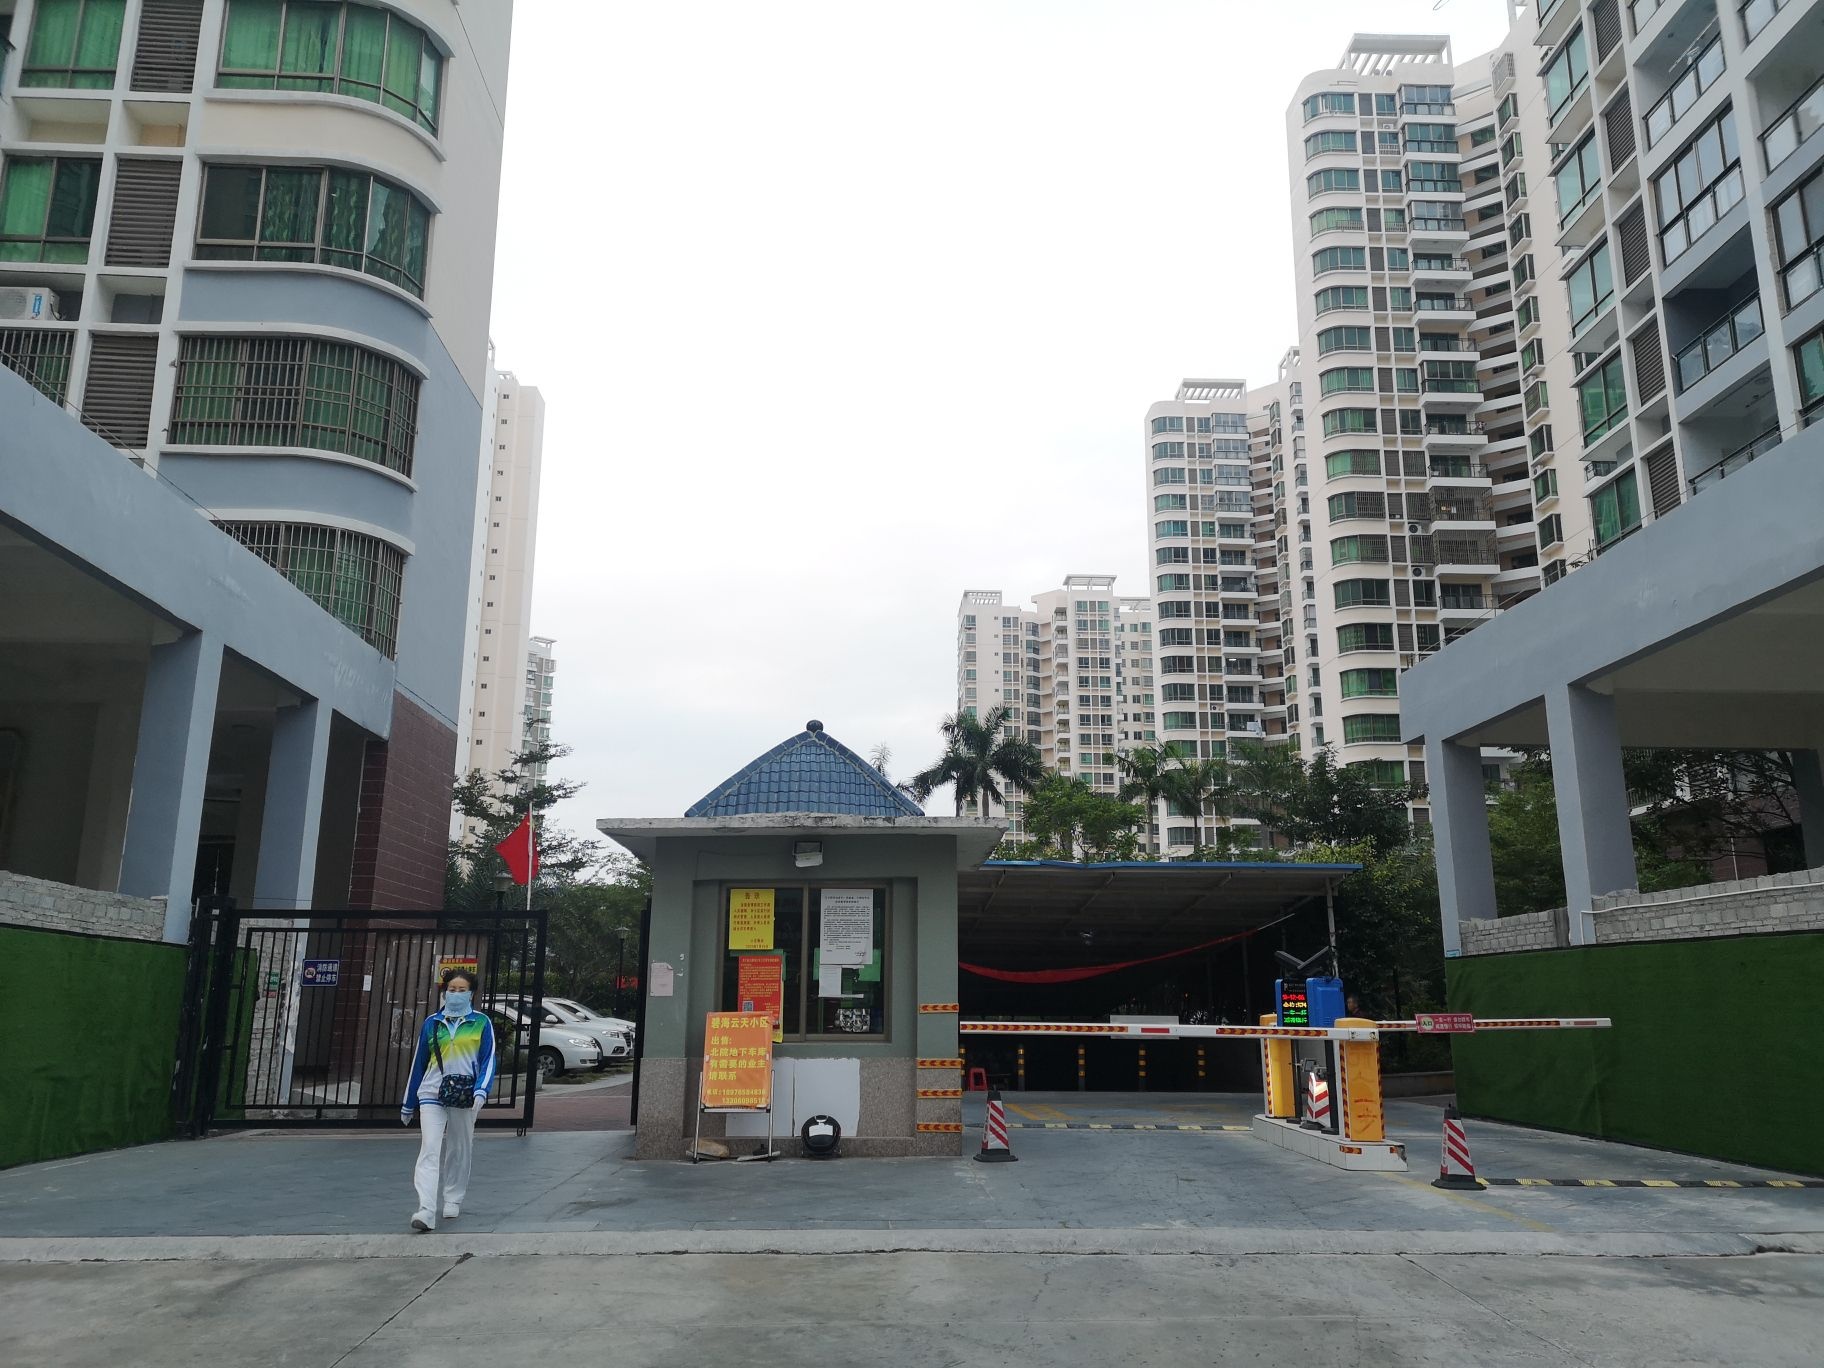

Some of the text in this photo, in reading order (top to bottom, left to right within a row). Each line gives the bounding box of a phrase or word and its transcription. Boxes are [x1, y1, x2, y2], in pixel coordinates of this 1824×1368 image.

[711, 1016, 769, 1029] 碧海云天小区
[710, 1047, 767, 1057] 北院地下车库
[710, 1059, 767, 1069] 有需要的业主
[708, 1071, 737, 1081] 请联系
